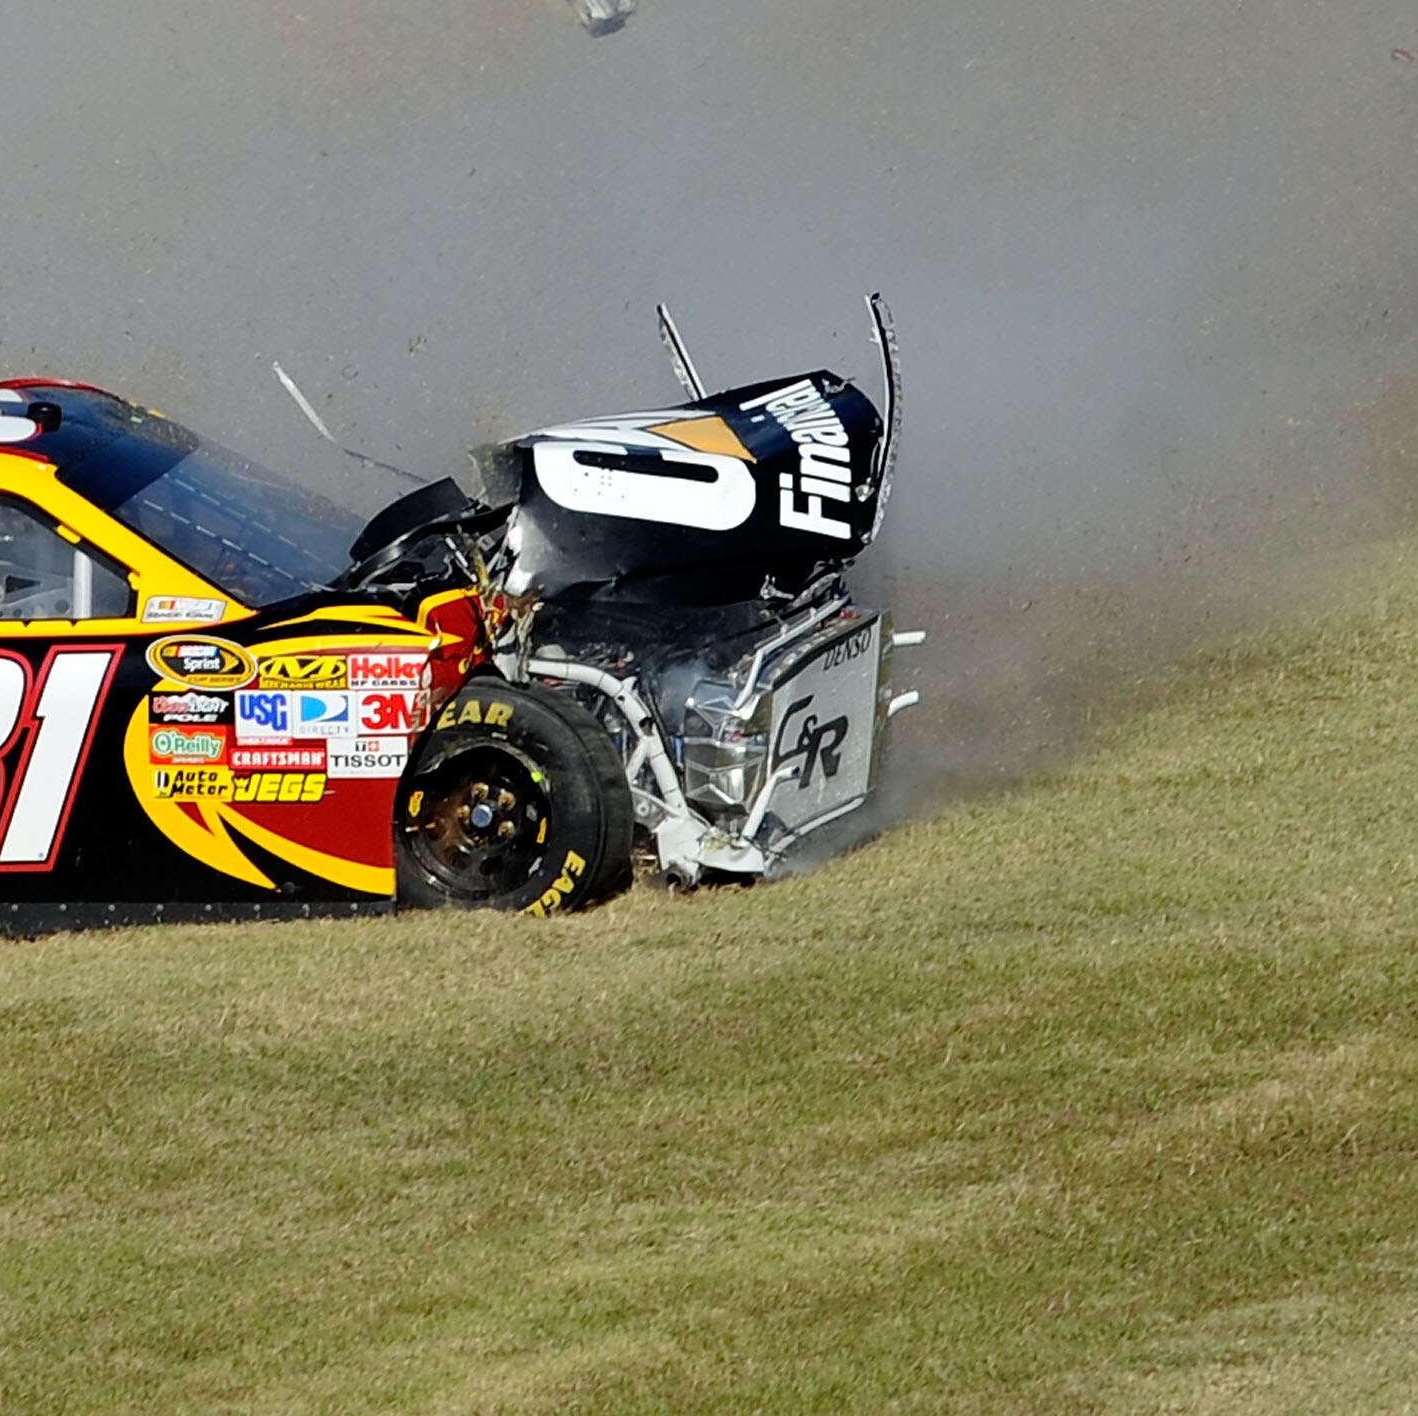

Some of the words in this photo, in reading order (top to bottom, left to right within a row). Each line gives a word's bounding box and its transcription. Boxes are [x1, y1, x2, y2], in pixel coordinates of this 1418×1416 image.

[823, 627, 872, 671] DENSO
[183, 657, 221, 673] Sprint
[351, 657, 423, 680] Holley
[239, 693, 288, 732] USG
[361, 693, 427, 731] 3M
[154, 732, 222, 759] O'Reilly
[772, 694, 849, 790] C&R
[233, 751, 325, 766] CRAFTSMAN
[330, 754, 406, 768] TISSOT
[175, 770, 219, 782] Auto
[234, 773, 327, 802] JEGS
[170, 785, 229, 798] Meter
